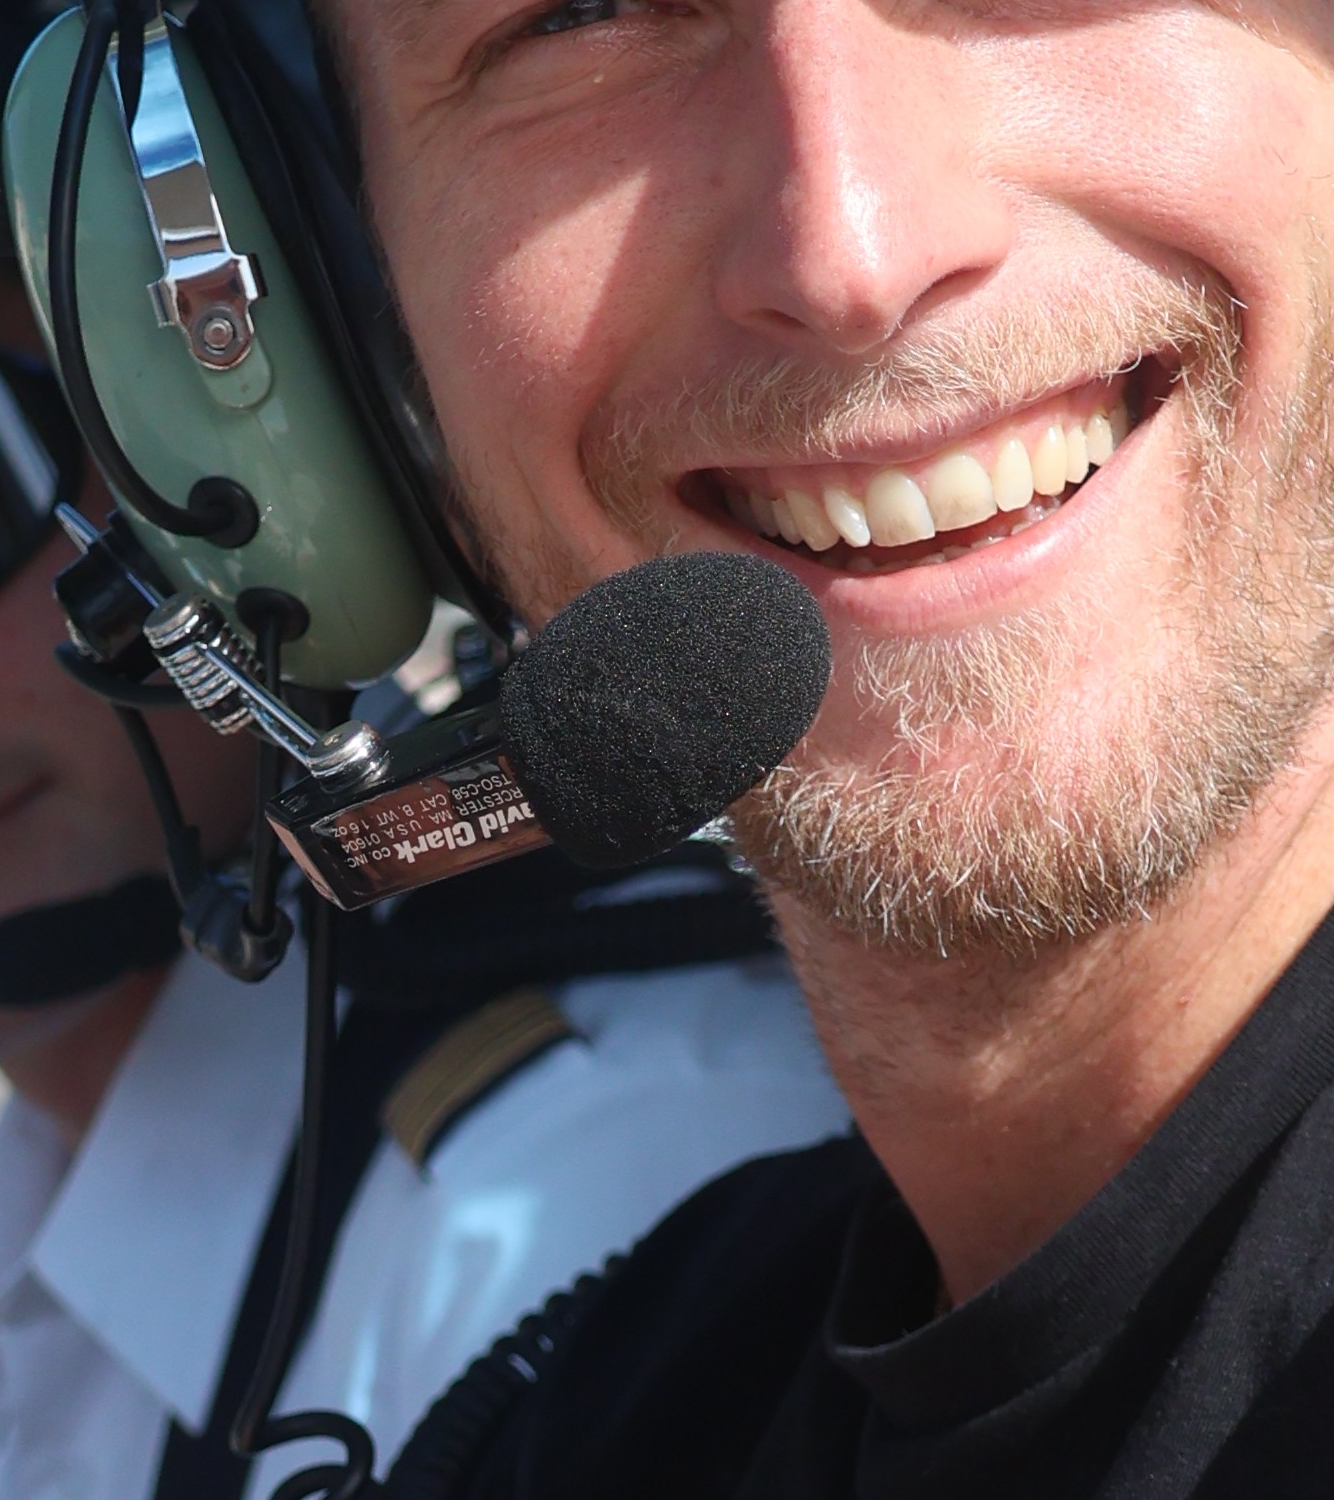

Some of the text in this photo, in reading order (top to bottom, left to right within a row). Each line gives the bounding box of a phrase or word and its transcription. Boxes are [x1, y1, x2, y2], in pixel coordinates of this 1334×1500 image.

[452, 786, 524, 816] RCESTER,
[478, 801, 535, 839] avid
[341, 833, 381, 854] 01604
[392, 821, 476, 864] Clark
